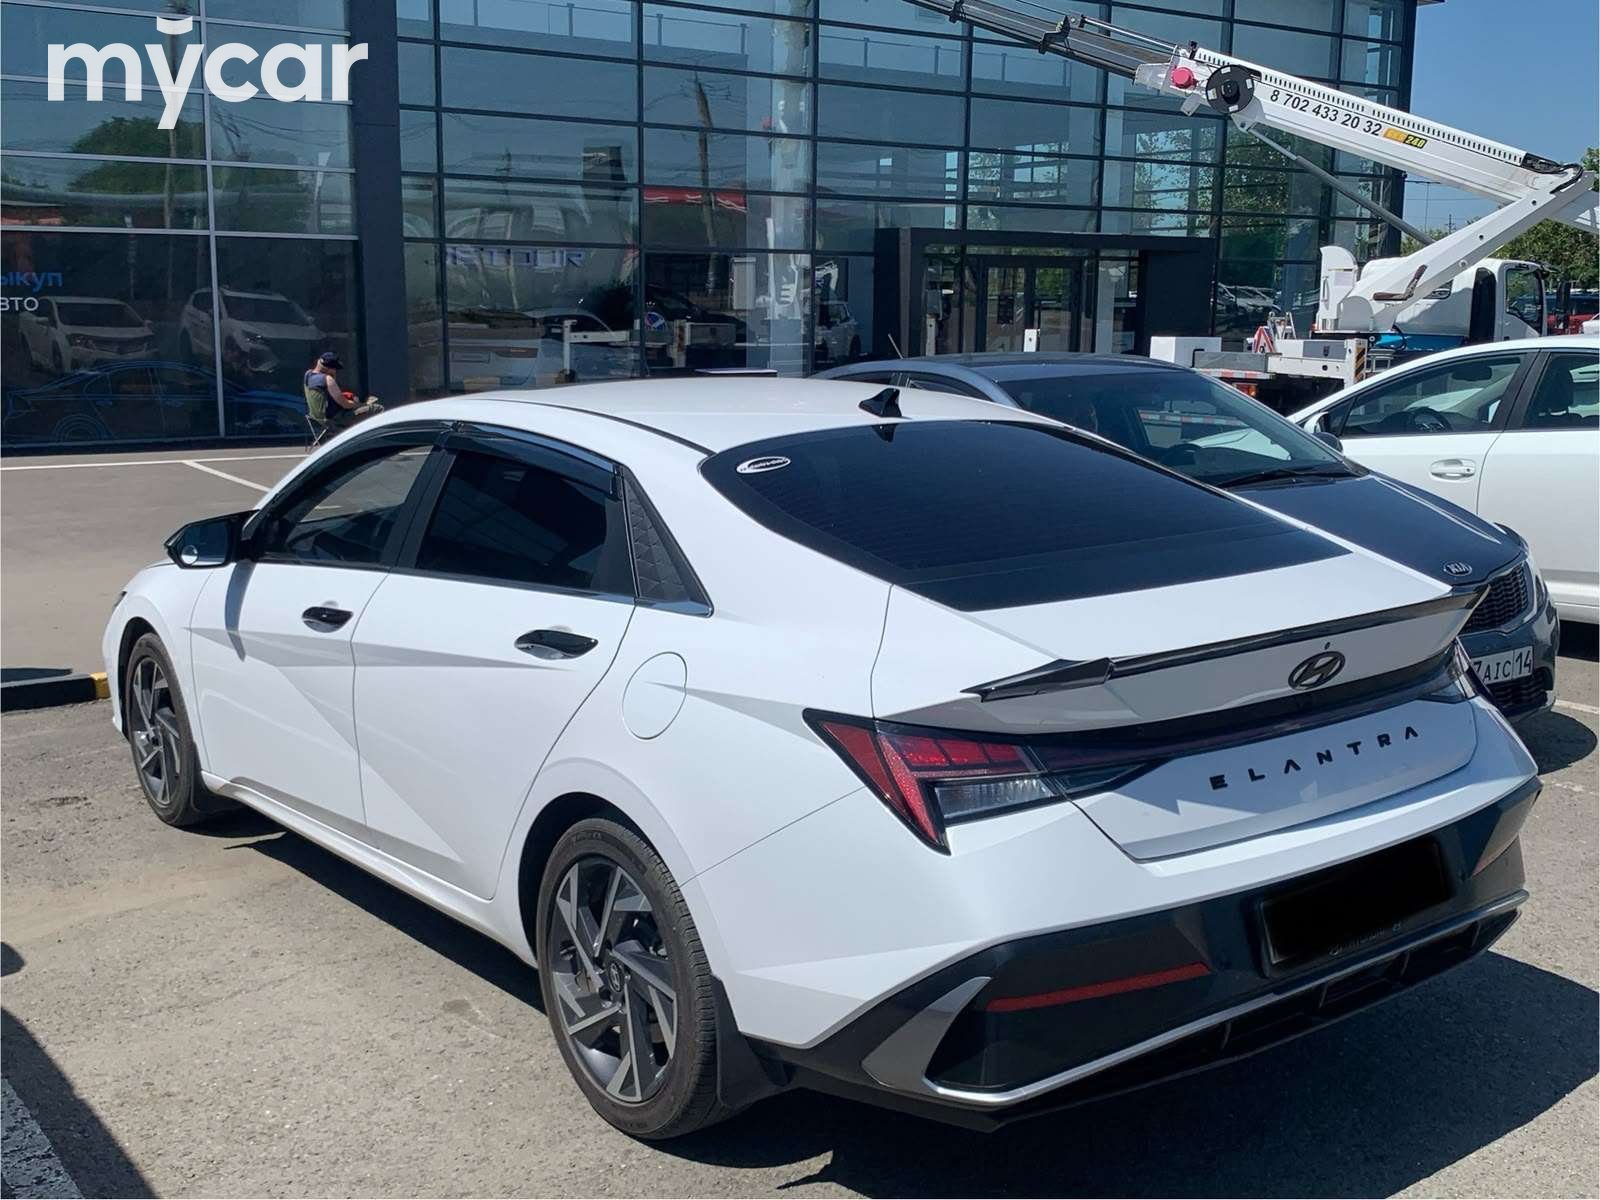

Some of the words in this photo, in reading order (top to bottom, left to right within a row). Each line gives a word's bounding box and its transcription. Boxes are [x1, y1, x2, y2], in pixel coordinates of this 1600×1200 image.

[1270, 89, 1279, 102] 8
[1283, 93, 1310, 112] 702
[1312, 104, 1339, 122] 433
[1341, 113, 1361, 129] 20
[1363, 120, 1382, 136] 32
[1515, 650, 1533, 675] 14
[1209, 726, 1418, 790] ELANTRA
